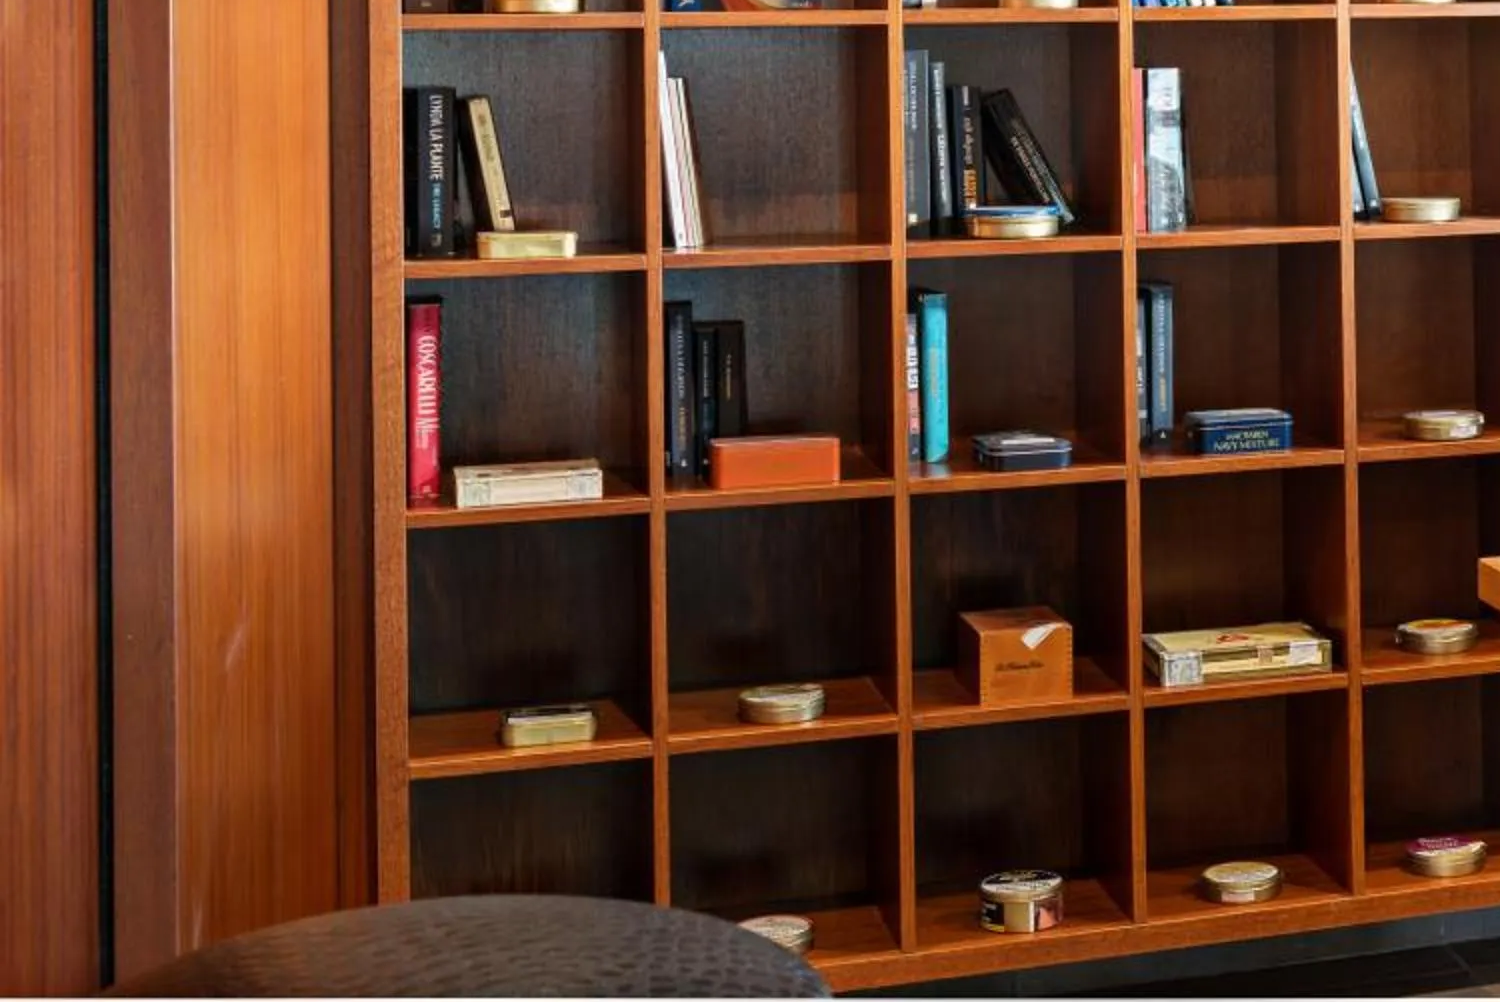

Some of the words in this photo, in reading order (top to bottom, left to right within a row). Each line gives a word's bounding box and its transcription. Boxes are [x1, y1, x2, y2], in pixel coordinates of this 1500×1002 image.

[429, 94, 444, 127] LYNDA
[429, 128, 444, 142] LA
[429, 143, 444, 181] PLANTE
[417, 334, 438, 415] COSCARELLI
